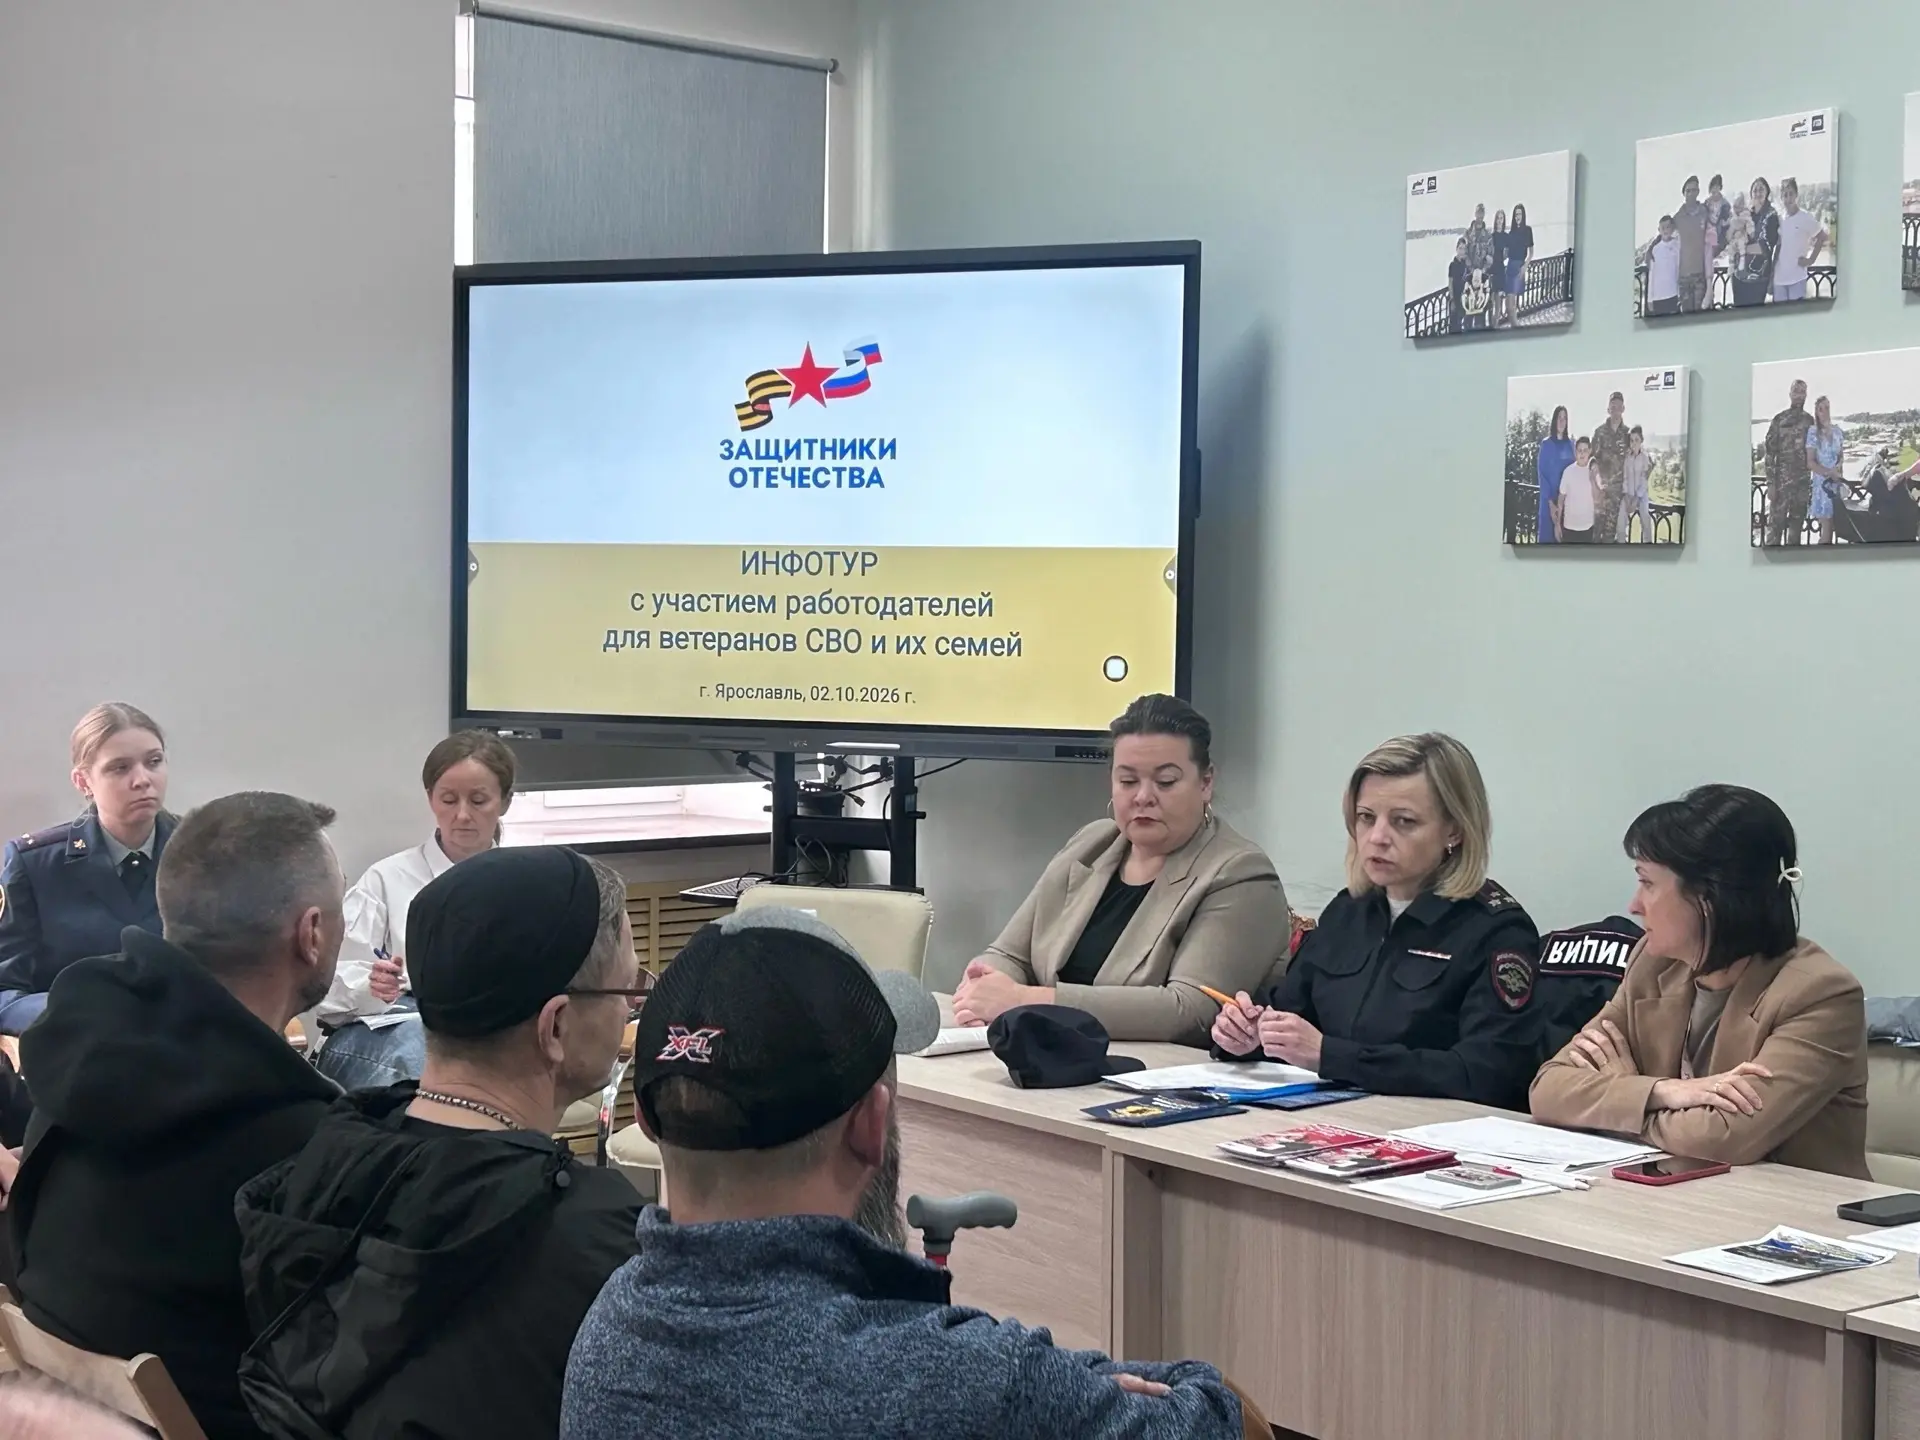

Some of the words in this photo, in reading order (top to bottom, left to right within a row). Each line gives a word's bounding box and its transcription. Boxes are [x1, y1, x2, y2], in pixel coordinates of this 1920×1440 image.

[719, 437, 897, 464] ЗАЩИТНИКИ
[728, 465, 886, 489] ОТЕЧЕСТВА
[741, 549, 878, 577] ИНФОТУР
[630, 593, 645, 612] с
[652, 591, 777, 618] участием
[785, 590, 993, 620] работодателей
[602, 629, 651, 654] для
[659, 630, 797, 658] ветеранов
[805, 628, 862, 654] СВО
[871, 635, 886, 655] и
[895, 636, 927, 656] их
[935, 632, 1022, 658] семей
[699, 686, 711, 698] г.
[715, 684, 806, 703] Ярославль,
[810, 685, 900, 704] 02.10.2026
[904, 690, 917, 704] г.
[1547, 935, 1630, 968] ЛИЦИЯ
[660, 1030, 716, 1057] XFL
